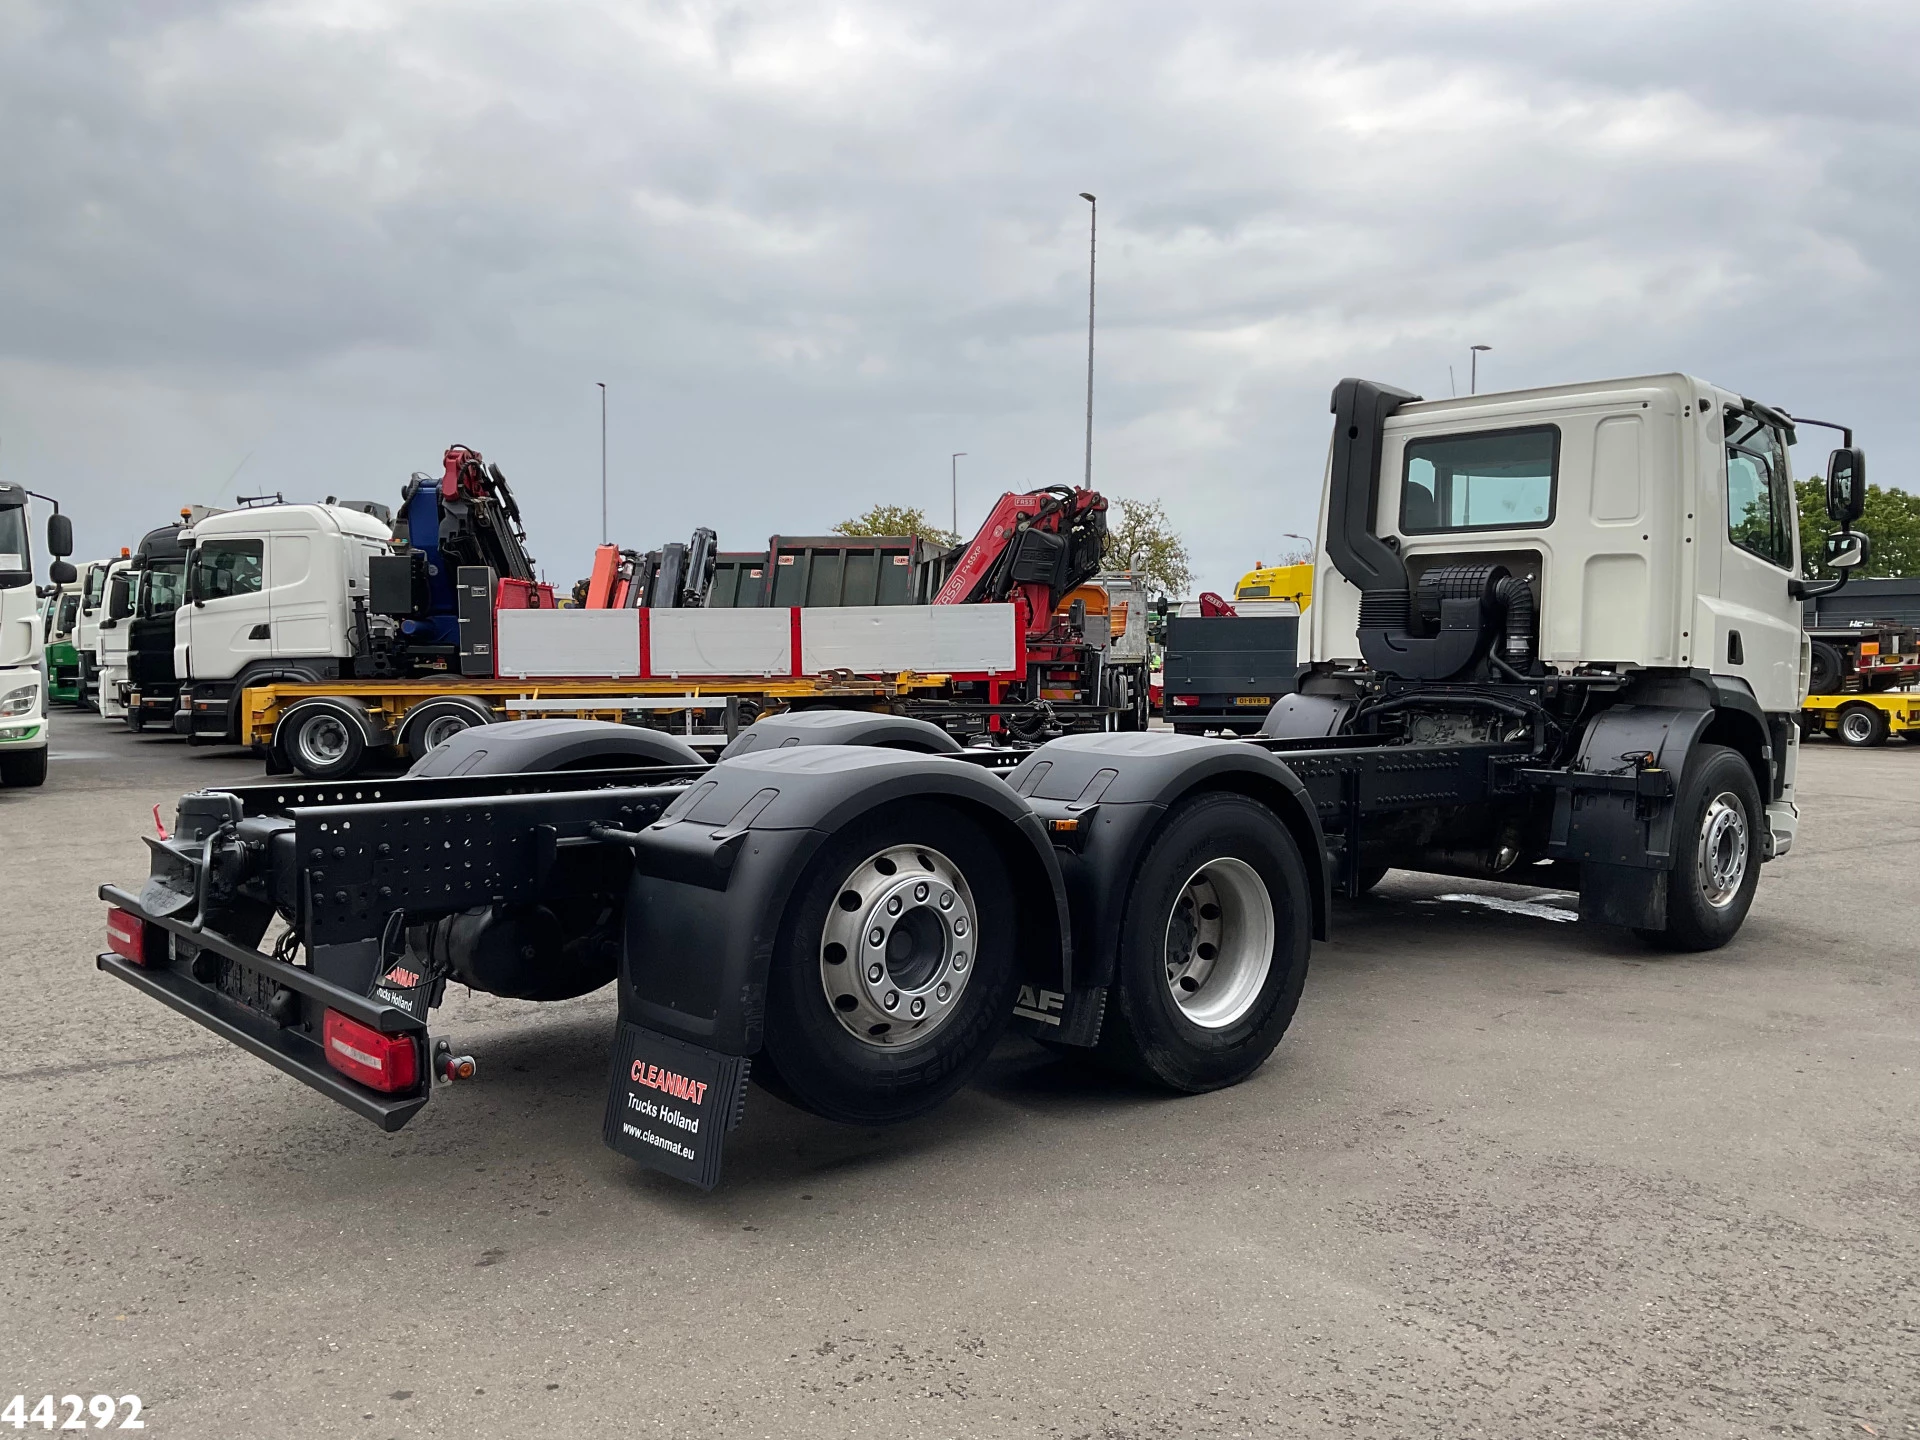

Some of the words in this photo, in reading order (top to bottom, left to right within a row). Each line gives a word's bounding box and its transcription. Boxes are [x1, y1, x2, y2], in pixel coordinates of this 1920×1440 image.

[938, 578, 963, 605] ASSI
[962, 546, 981, 574] F455XP
[391, 992, 412, 1011] Holland
[1016, 985, 1065, 1011] AF
[631, 1060, 707, 1105] CLEANMAT
[628, 1092, 657, 1117] Trucks
[660, 1105, 699, 1133] Holland
[623, 1122, 694, 1160] www.cleanmat.eu
